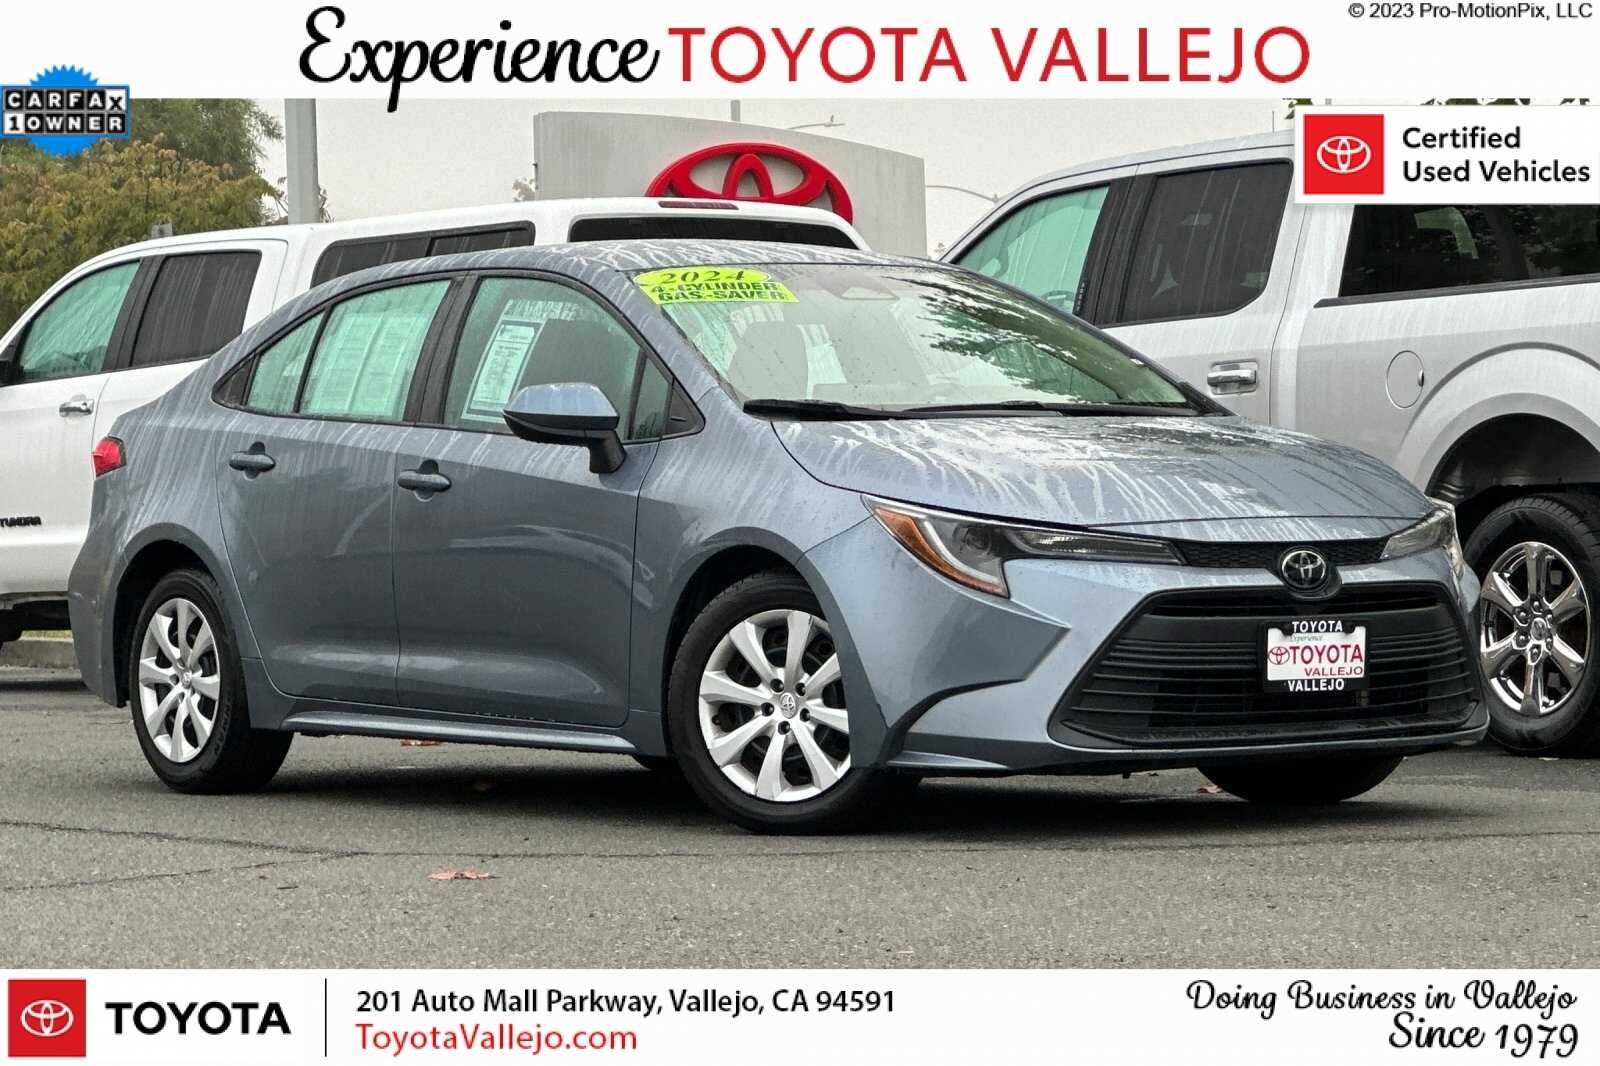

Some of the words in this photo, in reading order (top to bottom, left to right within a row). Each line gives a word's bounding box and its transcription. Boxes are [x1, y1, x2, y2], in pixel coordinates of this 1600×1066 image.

[660, 270, 746, 285] 2024
[657, 289, 786, 301] GAS-SAVER
[1291, 620, 1343, 633] TOYOTA
[1289, 644, 1363, 665] TOYOTA
[1304, 666, 1363, 676] VALLEJO
[1287, 679, 1345, 692] VALLEJO
